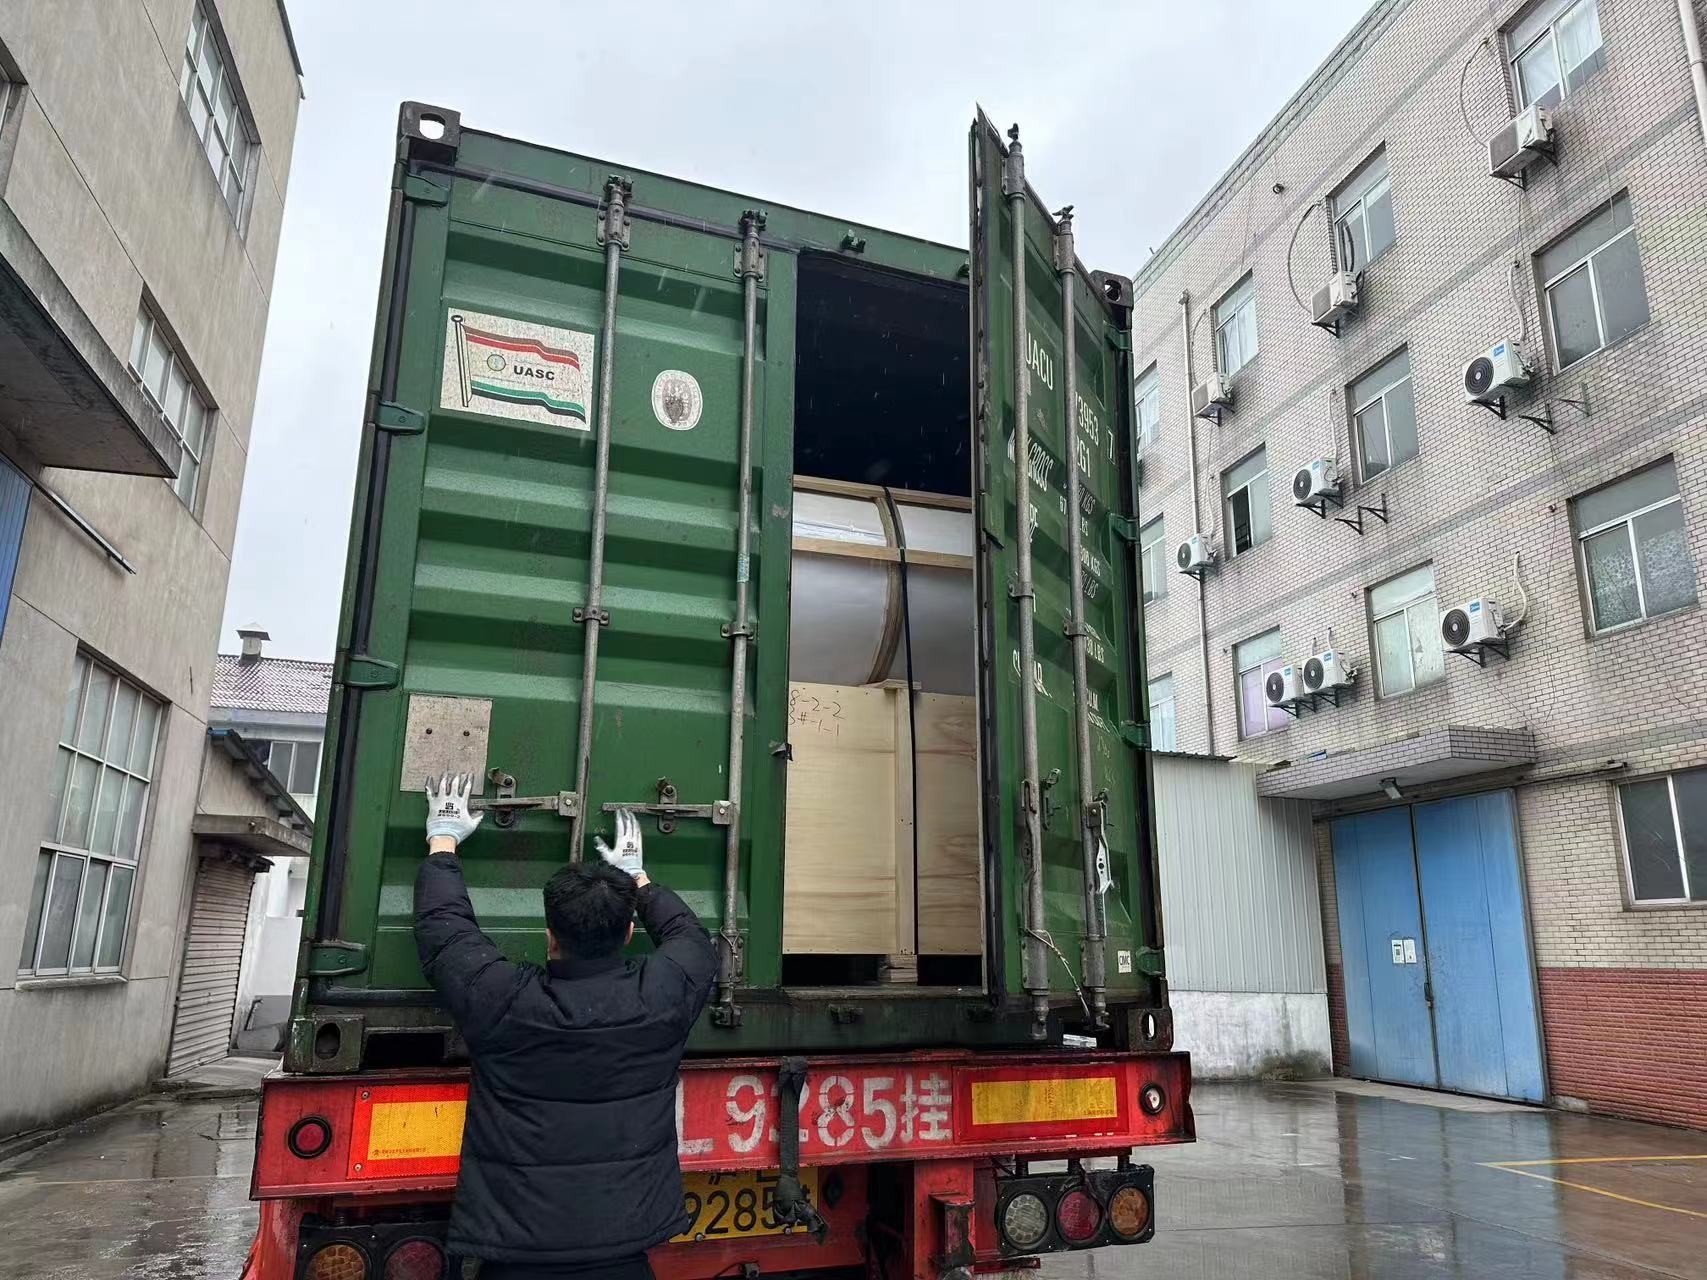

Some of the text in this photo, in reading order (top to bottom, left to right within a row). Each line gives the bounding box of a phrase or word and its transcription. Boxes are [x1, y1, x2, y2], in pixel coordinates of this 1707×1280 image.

[513, 365, 556, 381] UASC
[1024, 328, 1053, 391] UACU
[681, 1184, 812, 1236] 9285
